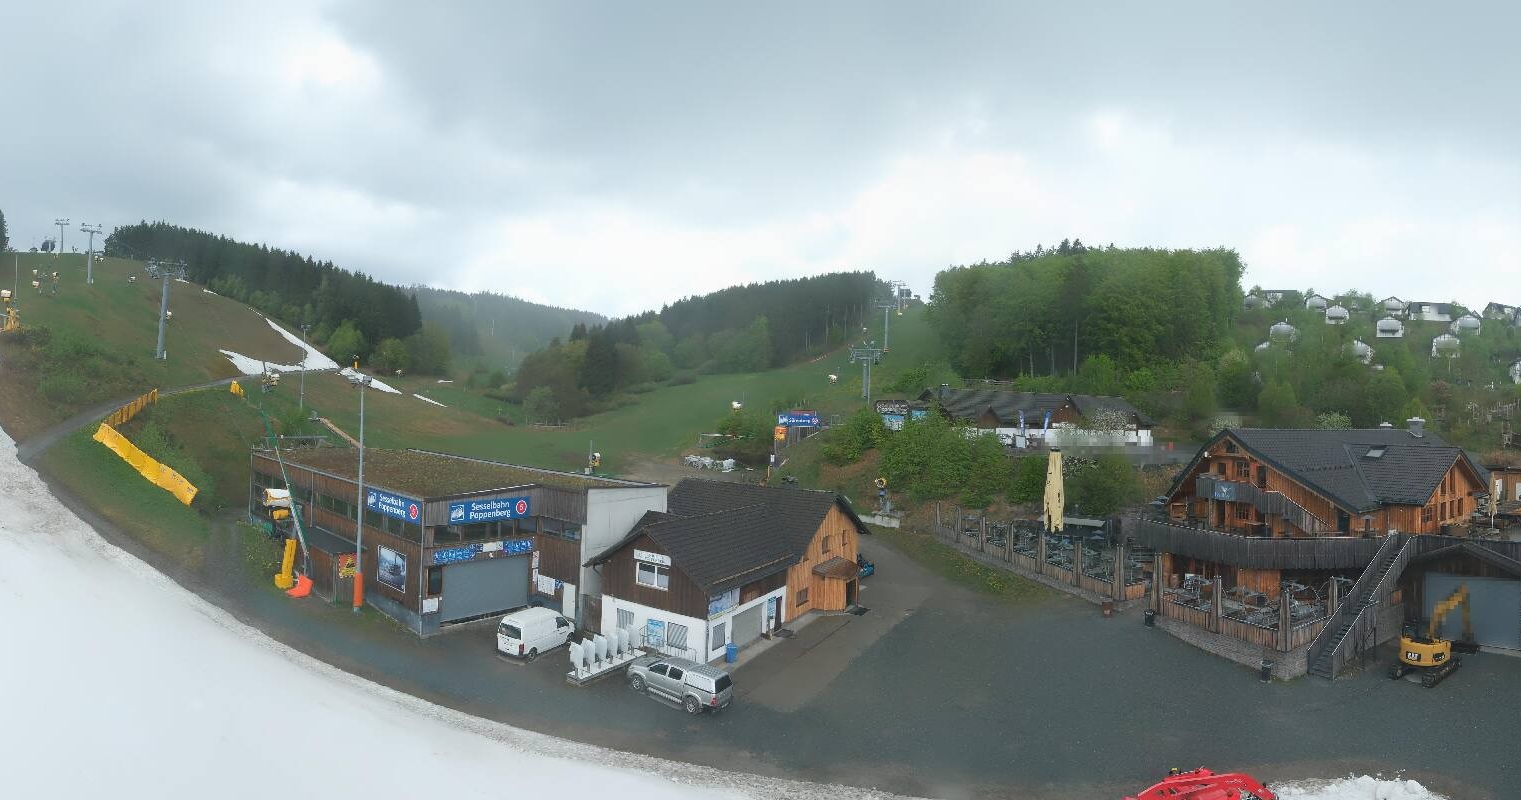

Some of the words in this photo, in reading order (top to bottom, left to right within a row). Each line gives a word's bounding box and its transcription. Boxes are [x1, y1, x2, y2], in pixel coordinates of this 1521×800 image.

[379, 493, 405, 507] Sesselbahn
[471, 500, 510, 511] Sesselbahn
[378, 502, 406, 518] Poppenberg
[469, 509, 511, 520] Poppenberg
